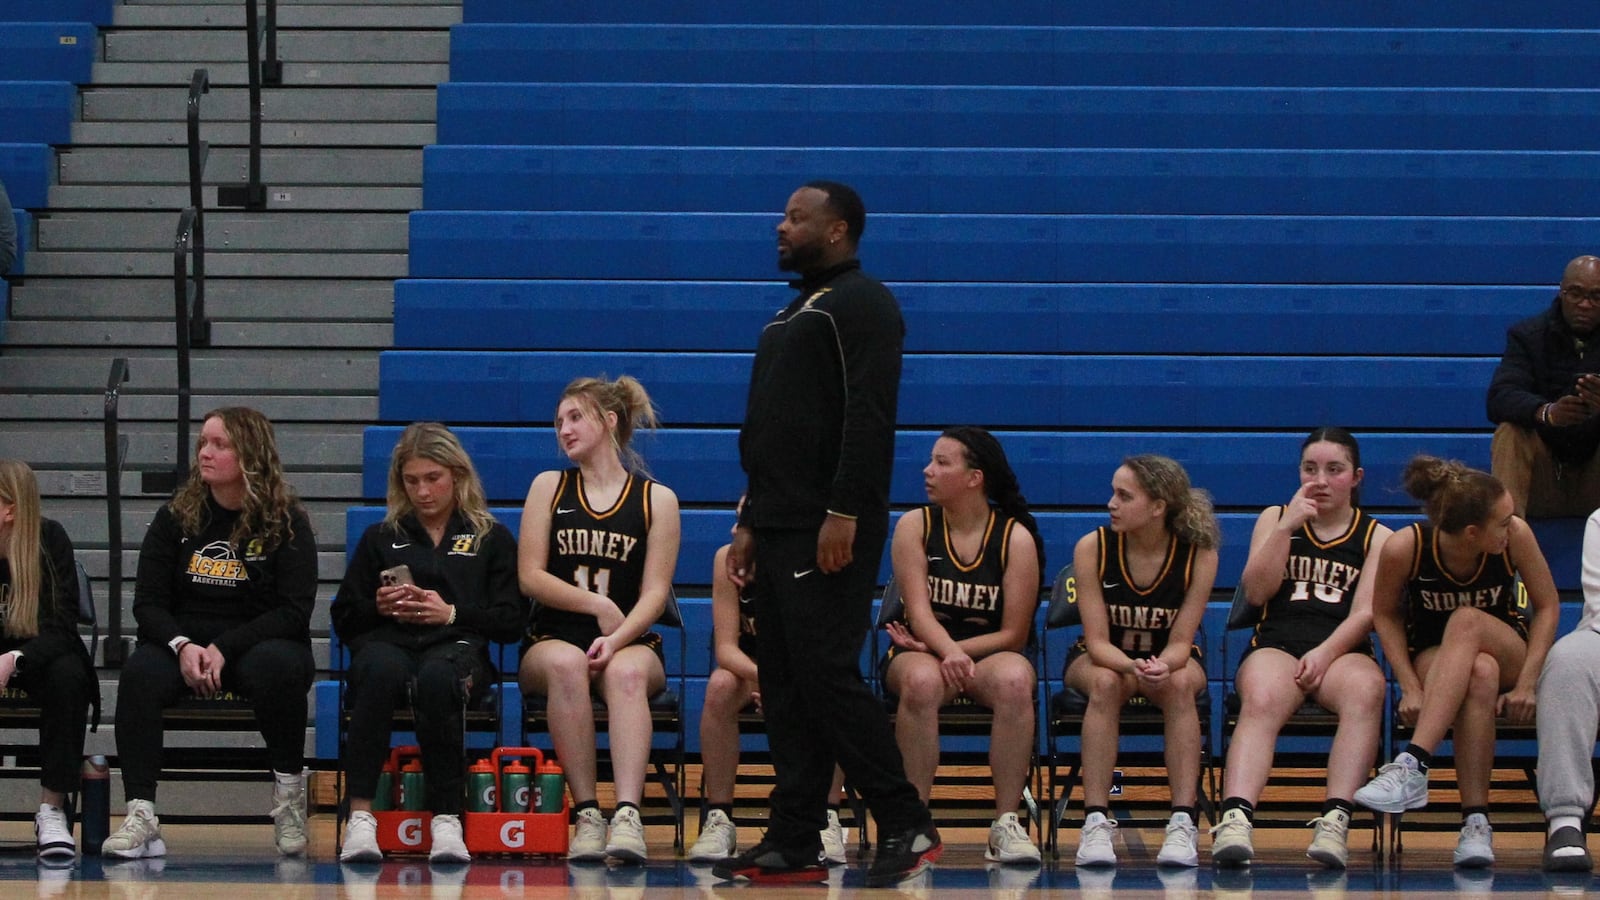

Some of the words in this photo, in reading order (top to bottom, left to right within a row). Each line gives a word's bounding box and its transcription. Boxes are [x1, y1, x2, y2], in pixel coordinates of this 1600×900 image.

[557, 528, 638, 562] SIDNEY
[191, 575, 238, 588] BASKETBALL
[1421, 585, 1503, 611] SIDNEY
[1106, 603, 1179, 630] IDNEY
[397, 817, 423, 847] G
[500, 819, 526, 849] G
